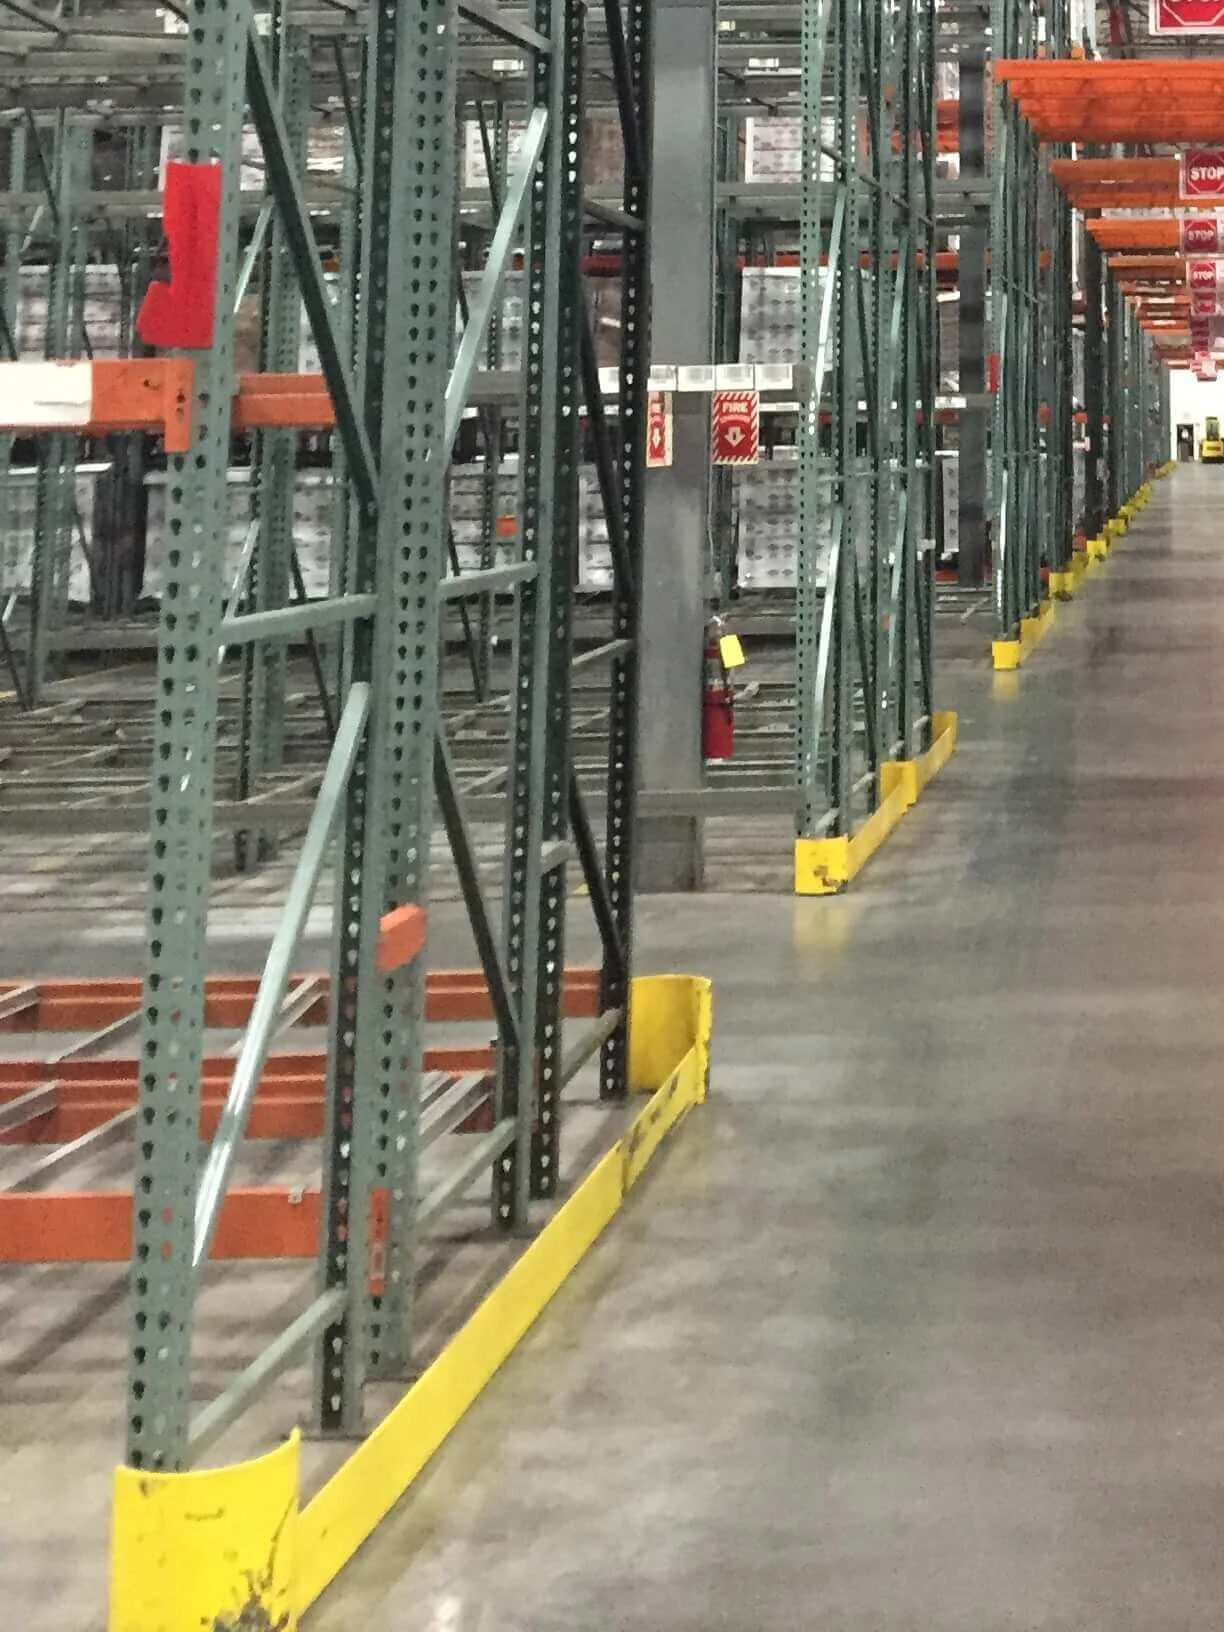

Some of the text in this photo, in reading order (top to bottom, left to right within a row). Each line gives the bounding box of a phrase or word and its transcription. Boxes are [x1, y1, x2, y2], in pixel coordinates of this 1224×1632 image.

[1190, 167, 1224, 181] STOP
[1188, 230, 1214, 241] STOP
[1193, 271, 1214, 280] STOP
[722, 401, 749, 413] FIRE
